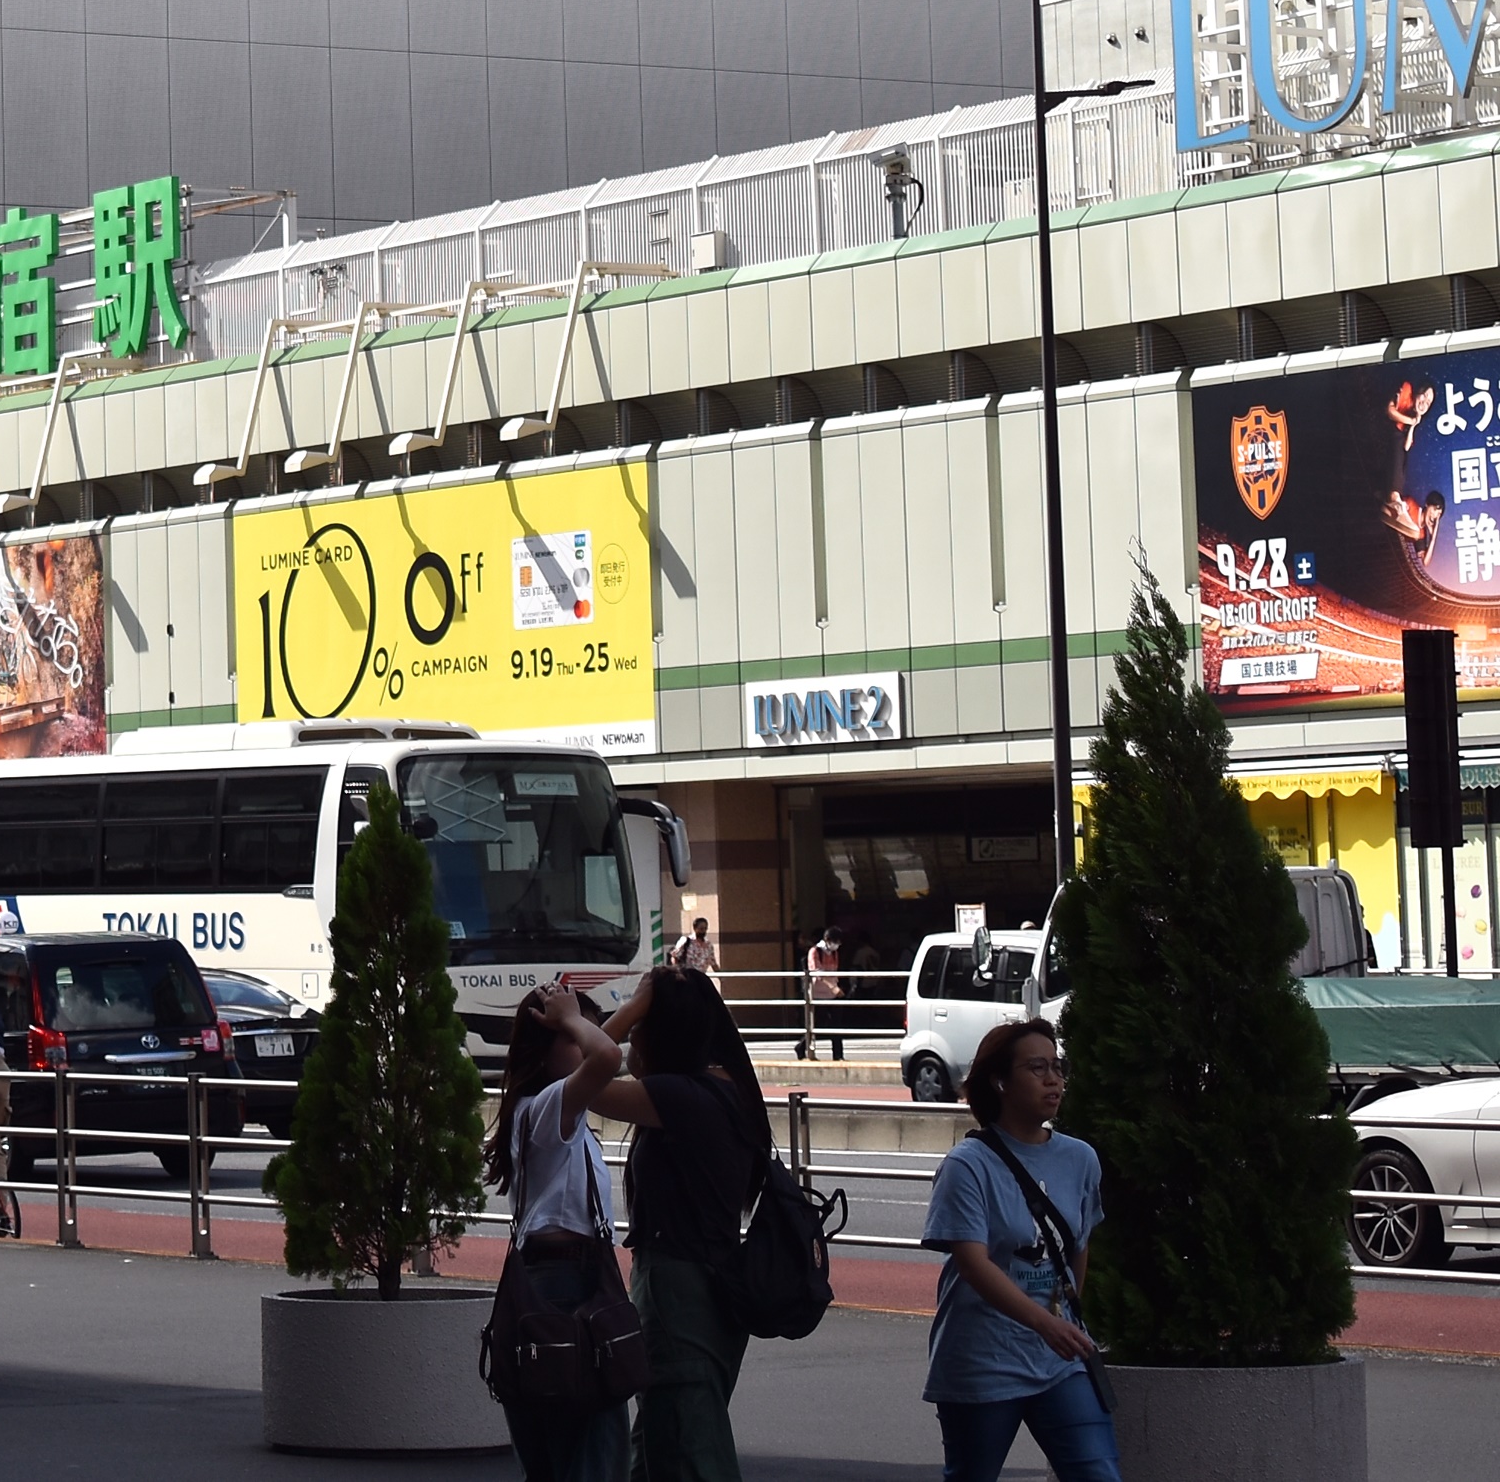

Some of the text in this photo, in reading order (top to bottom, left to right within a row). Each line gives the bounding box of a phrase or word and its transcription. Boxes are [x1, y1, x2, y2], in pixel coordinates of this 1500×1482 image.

[1436, 377, 1500, 435] よう
[261, 544, 353, 572] LUMINE CARD
[1216, 537, 1313, 592] 9.28 土
[1219, 596, 1317, 628] 18:00 KICKOFF
[411, 655, 489, 678] CAMPAIGN
[511, 647, 553, 680] 9.19
[557, 661, 575, 676] Thu
[614, 656, 638, 672] Wed
[1241, 659, 1298, 679] 国立競技場
[753, 685, 887, 736] LUMINE 2
[193, 911, 245, 950] BUS
[460, 974, 537, 988] TOKAI BUS
